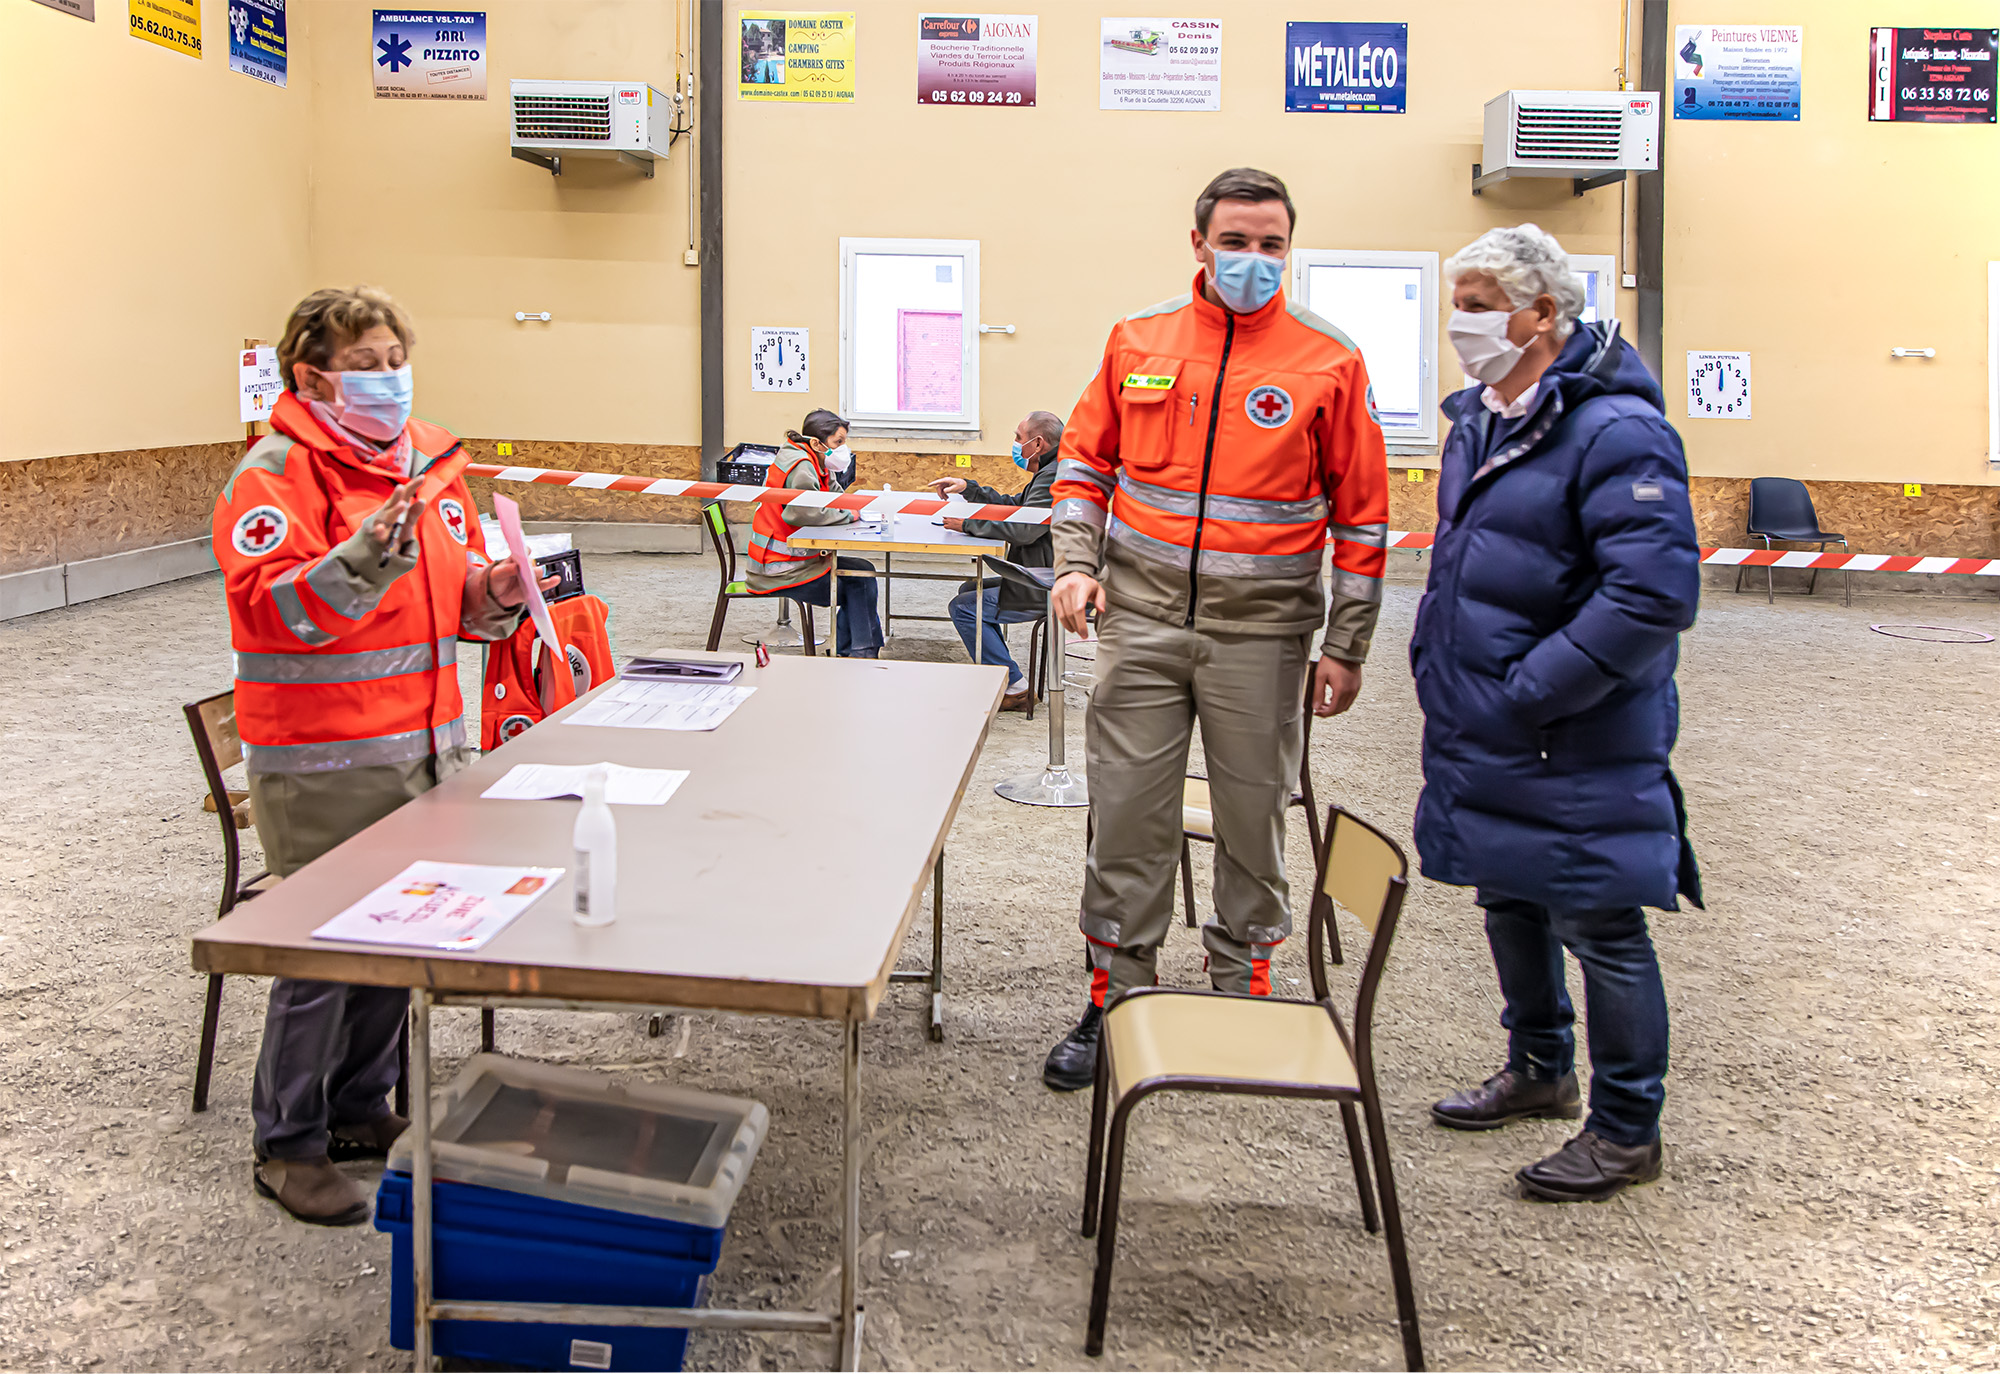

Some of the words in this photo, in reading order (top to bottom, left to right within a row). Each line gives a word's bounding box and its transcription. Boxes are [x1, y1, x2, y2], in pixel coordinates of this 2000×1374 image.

[788, 20, 817, 29] DOMAINE
[820, 20, 843, 29] CASTEX
[923, 20, 960, 30] Carrefour
[983, 23, 1031, 37] AIGNAN
[130, 14, 202, 50] 05.62.03.75.36
[436, 30, 465, 42] SARL
[1712, 29, 1757, 42] Peintures
[1760, 29, 1798, 42] VIENNE
[788, 44, 819, 53] CAMPING
[424, 49, 480, 61] PIZZATO
[788, 59, 823, 69] CHAMBRES
[826, 60, 844, 69] GITES
[1294, 40, 1398, 88] MÉTALÉCO
[242, 64, 276, 83] 05.62.09.24.42
[932, 90, 947, 102] 05
[950, 91, 966, 102] 62
[969, 91, 984, 102] 09
[987, 92, 1003, 103] 24
[1006, 92, 1022, 103] 20
[1319, 91, 1376, 101] www.metaleco.com
[1901, 87, 1917, 100] 06
[1919, 87, 1935, 100] 33
[1937, 88, 1953, 100] 58
[1956, 88, 1971, 101] 72
[1973, 88, 1990, 101] 06
[778, 336, 782, 344] 0
[800, 353, 805, 361] 3
[1704, 363, 1713, 371] 13
[1716, 361, 1721, 369] 0
[259, 368, 271, 377] ZONE
[760, 371, 765, 379] 9
[796, 372, 801, 380] 5
[1696, 369, 1705, 377] 12
[788, 378, 792, 386] 6
[1742, 378, 1747, 386] 3
[1691, 388, 1701, 396] 10
[1698, 397, 1703, 405] 9
[1737, 398, 1742, 406] 5
[1706, 403, 1712, 412] 8
[1717, 406, 1722, 414] 7
[1728, 404, 1733, 412] 6
[1416, 551, 1422, 561] 3
[567, 651, 583, 676] UGE
